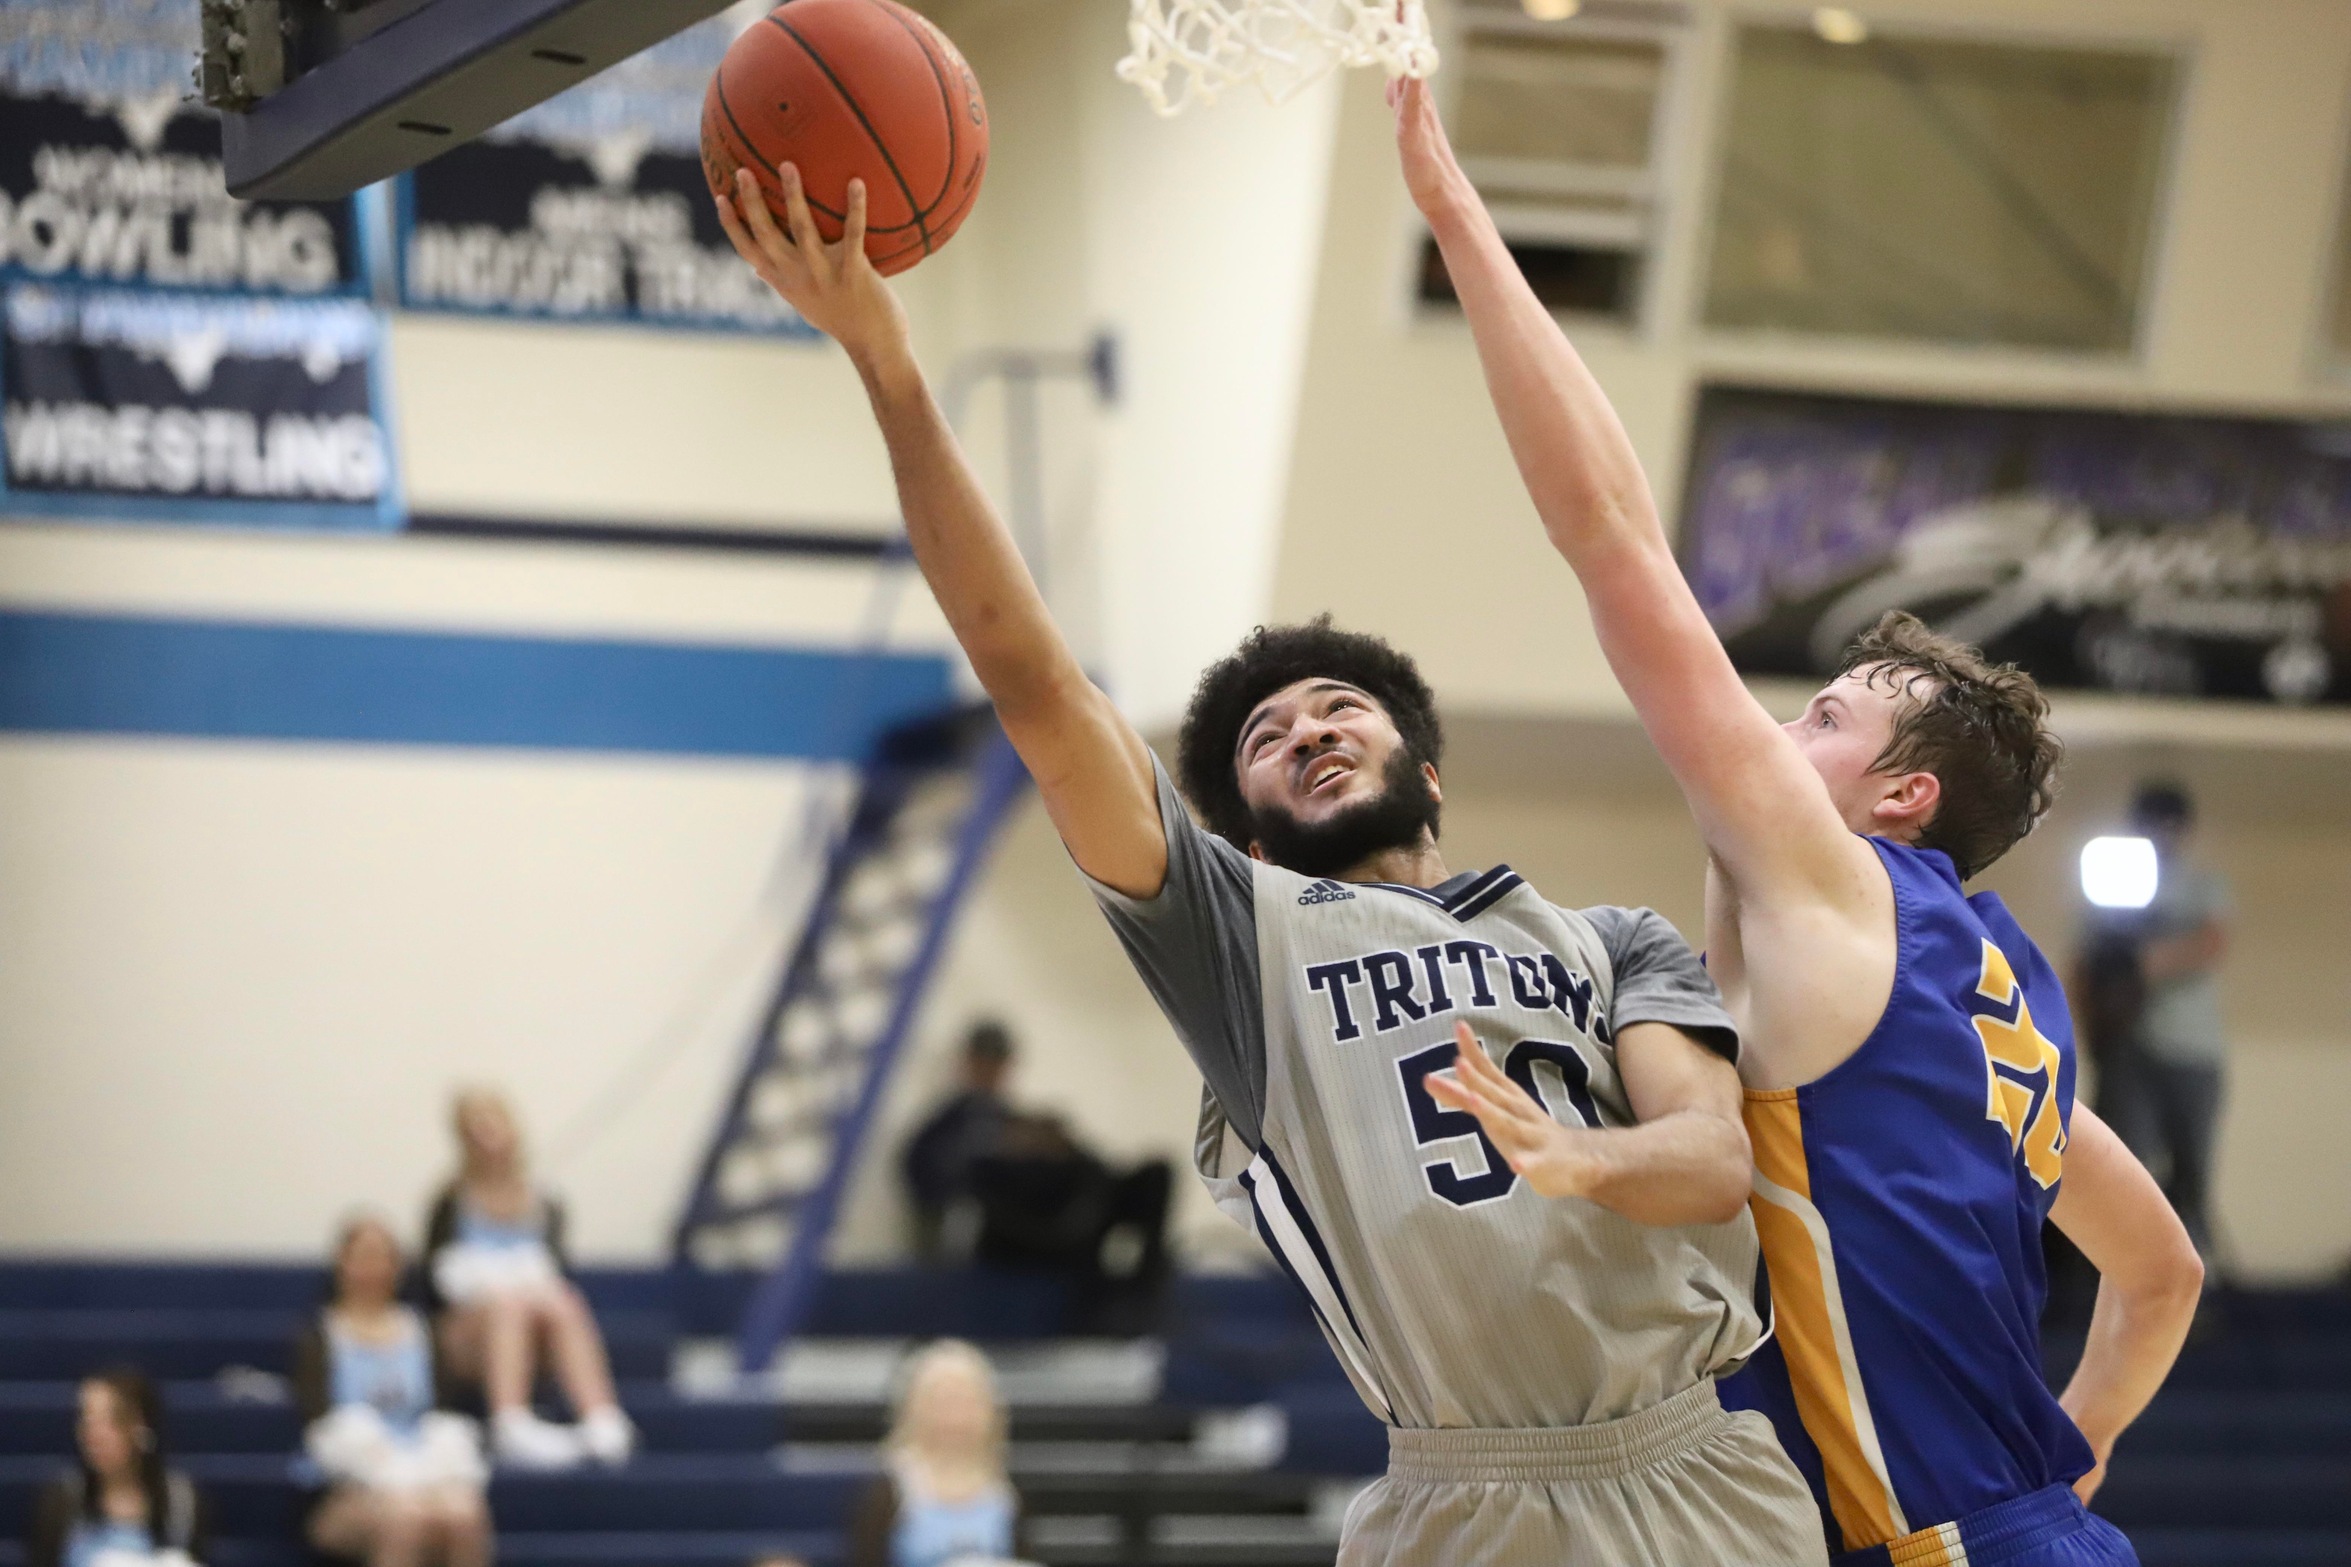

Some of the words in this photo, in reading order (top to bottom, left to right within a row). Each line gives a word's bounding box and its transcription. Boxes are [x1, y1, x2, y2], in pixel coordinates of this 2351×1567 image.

[0, 192, 338, 293] OWLING
[5, 402, 386, 498] WRESTLING
[1298, 891, 1356, 905] adidas
[1394, 1038, 1606, 1210] 50
